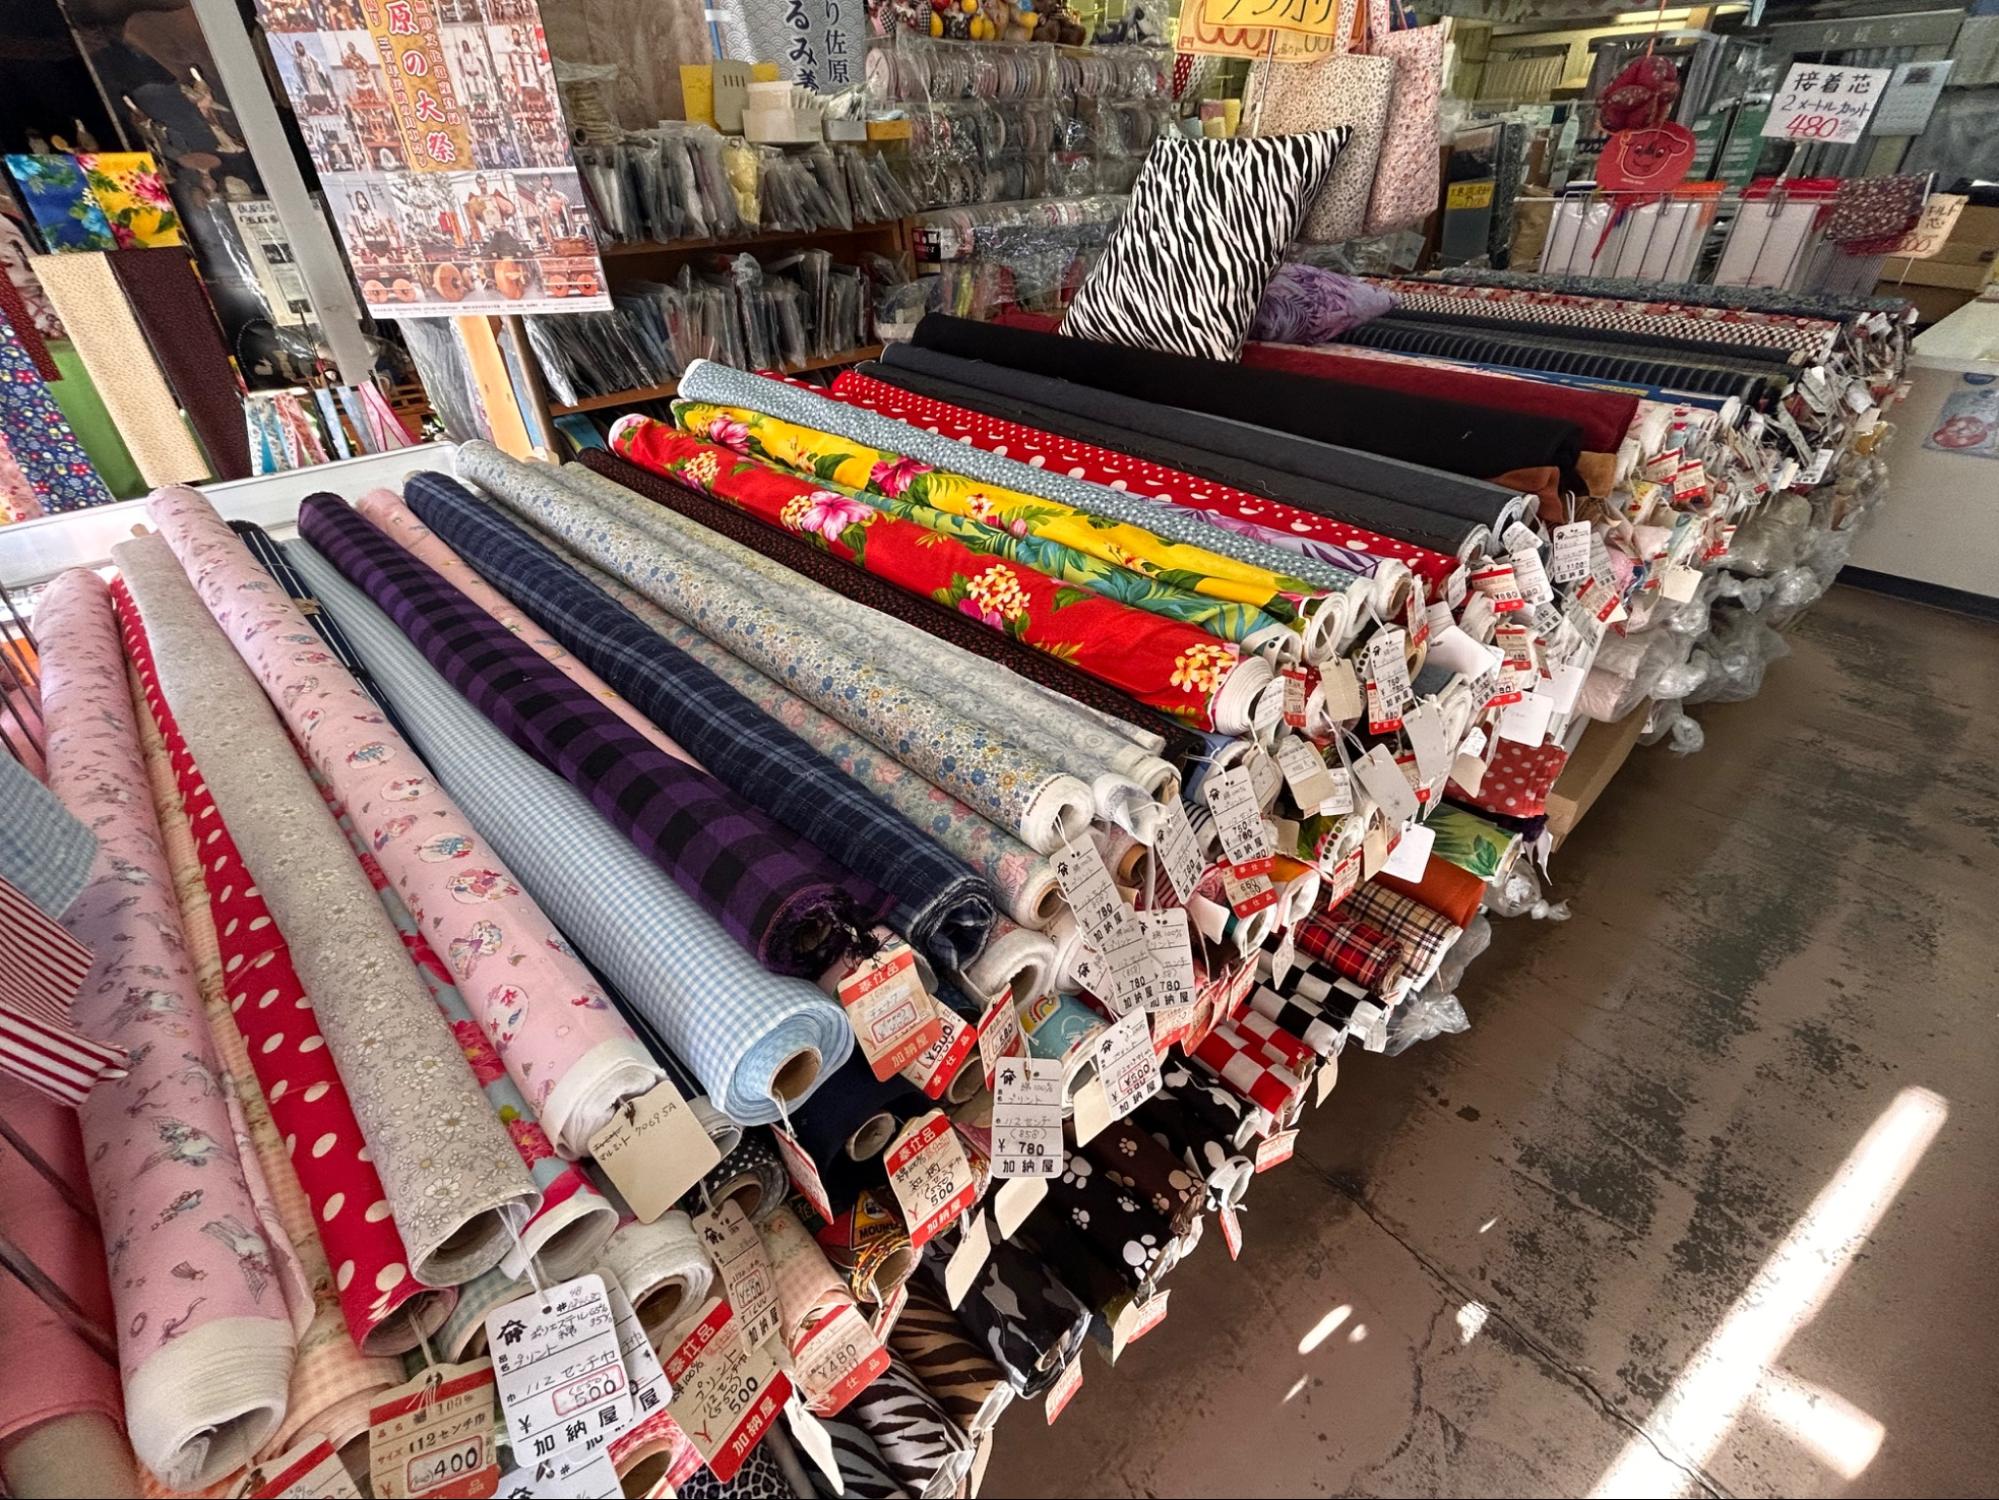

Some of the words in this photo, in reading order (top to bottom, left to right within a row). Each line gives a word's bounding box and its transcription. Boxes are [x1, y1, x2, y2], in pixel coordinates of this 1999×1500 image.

[825, 0, 849, 83] り佐原
[385, 1, 456, 162] 原の大祭
[1794, 71, 1872, 93] 接着芯
[1786, 113, 1839, 138] 480
[1096, 902, 1113, 920] 780
[858, 963, 899, 993] 奉仕品
[1130, 976, 1146, 989] 780
[1160, 980, 1181, 992] 780
[891, 1032, 927, 1068] 加納屋
[932, 1034, 971, 1087] 奉仕品
[1124, 1064, 1150, 1086] ¥500
[1120, 1080, 1156, 1114] 加納屋
[899, 1127, 936, 1161] 奉仕品
[998, 1138, 1006, 1153] ¥
[1018, 1141, 1045, 1157] 780
[1003, 1159, 1054, 1173] 加納屋
[930, 1181, 954, 1208] 500
[927, 1197, 961, 1234] 加納屋
[749, 1307, 779, 1346] 加納屋
[514, 1343, 558, 1366] プリント
[667, 1323, 715, 1377] 奉仕品
[695, 1349, 737, 1400] プリント
[574, 1380, 616, 1408] 500
[639, 1387, 661, 1412] 屋
[728, 1376, 759, 1415] 500
[518, 1414, 532, 1434] ¥
[533, 1405, 619, 1457] 加納屋
[732, 1395, 777, 1457] 加納屋
[434, 1446, 478, 1479] 400
